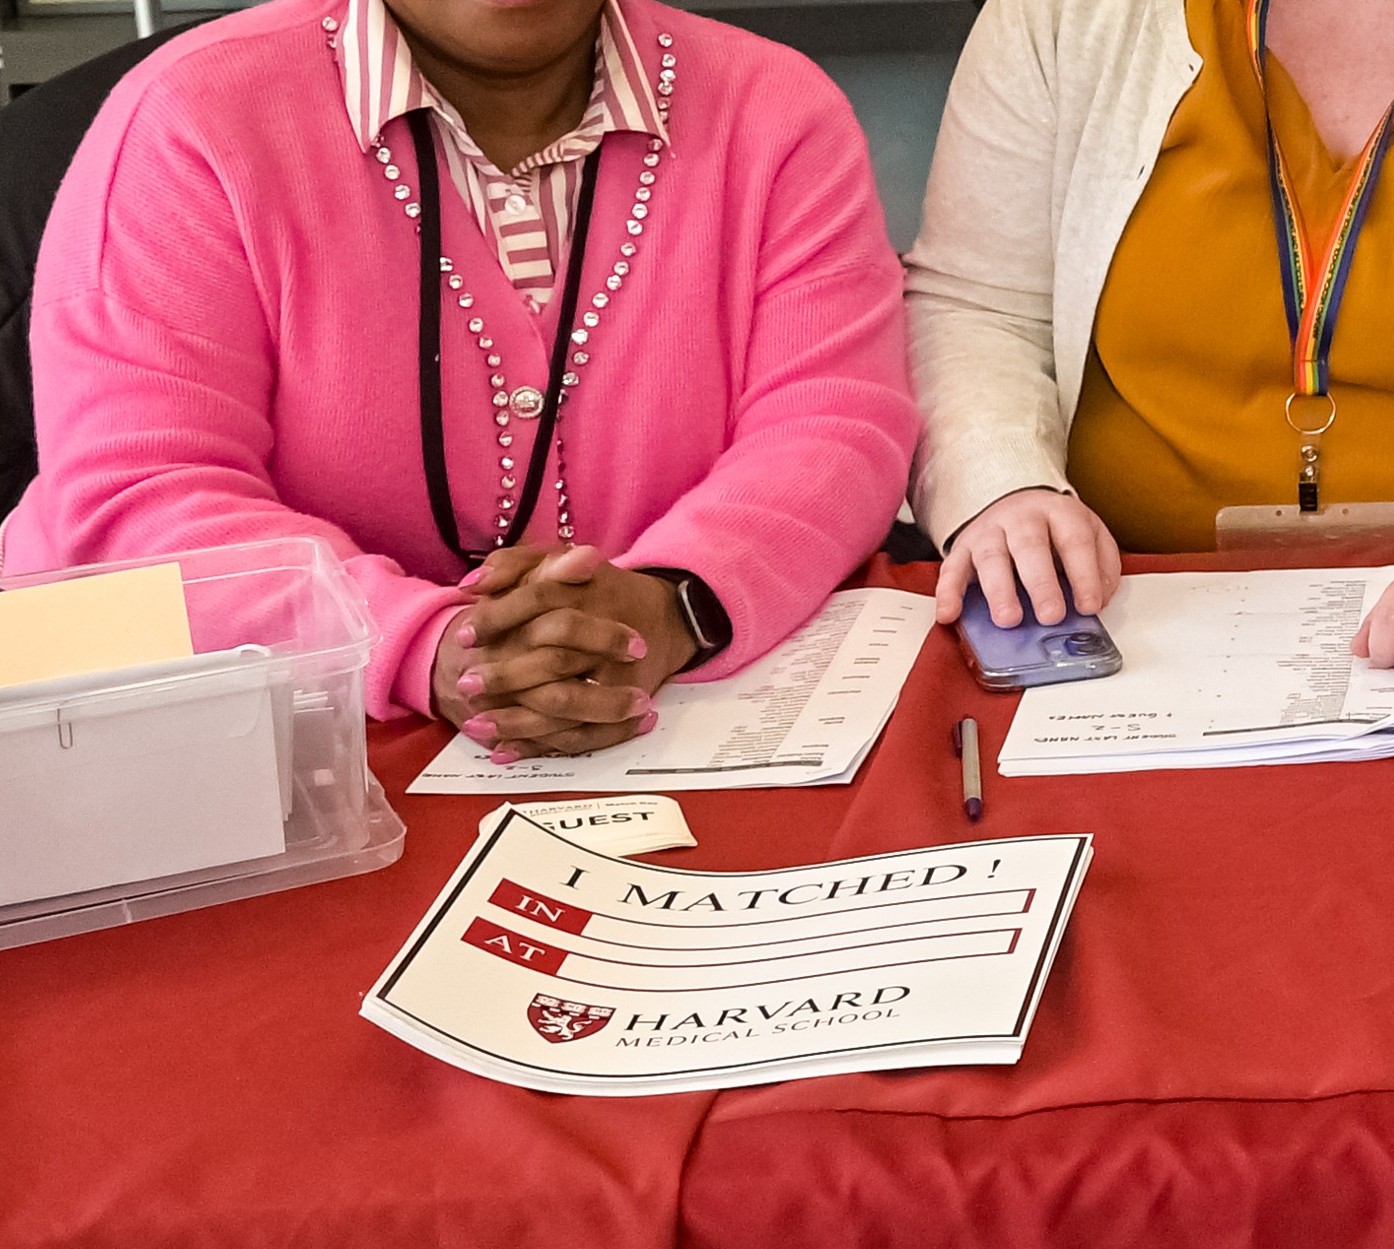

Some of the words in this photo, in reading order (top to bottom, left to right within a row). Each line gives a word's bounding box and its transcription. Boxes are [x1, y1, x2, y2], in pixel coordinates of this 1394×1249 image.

[559, 865, 590, 890] I
[514, 893, 568, 924] IN
[484, 933, 547, 963] AT
[625, 985, 911, 1032] HARVARD
[616, 1028, 760, 1048] MEDICAL
[772, 1008, 901, 1035] SCHOOL
